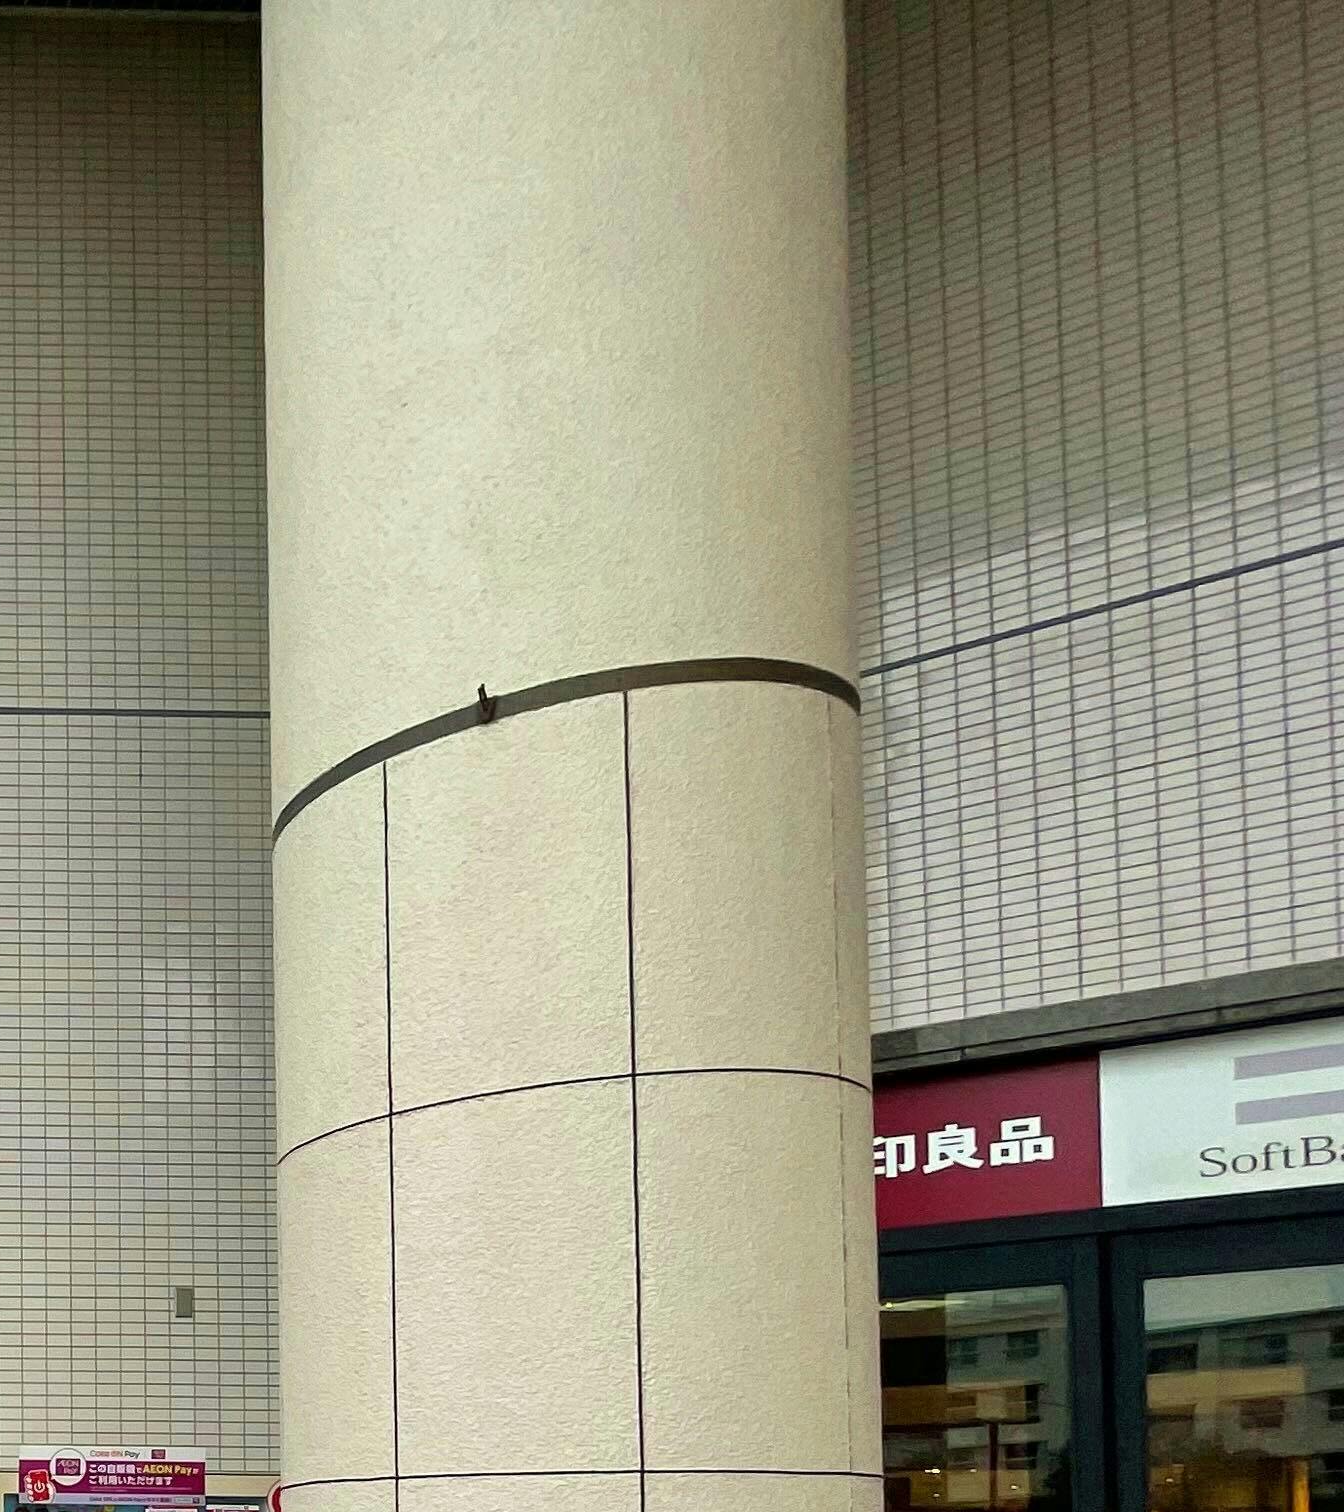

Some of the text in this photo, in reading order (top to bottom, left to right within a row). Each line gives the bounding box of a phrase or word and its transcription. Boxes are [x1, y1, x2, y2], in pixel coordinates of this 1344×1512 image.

[873, 1116, 1055, 1178] 印良品
[1199, 1135, 1344, 1178] SoftB
[88, 1475, 173, 1486] ご利用いただけます
